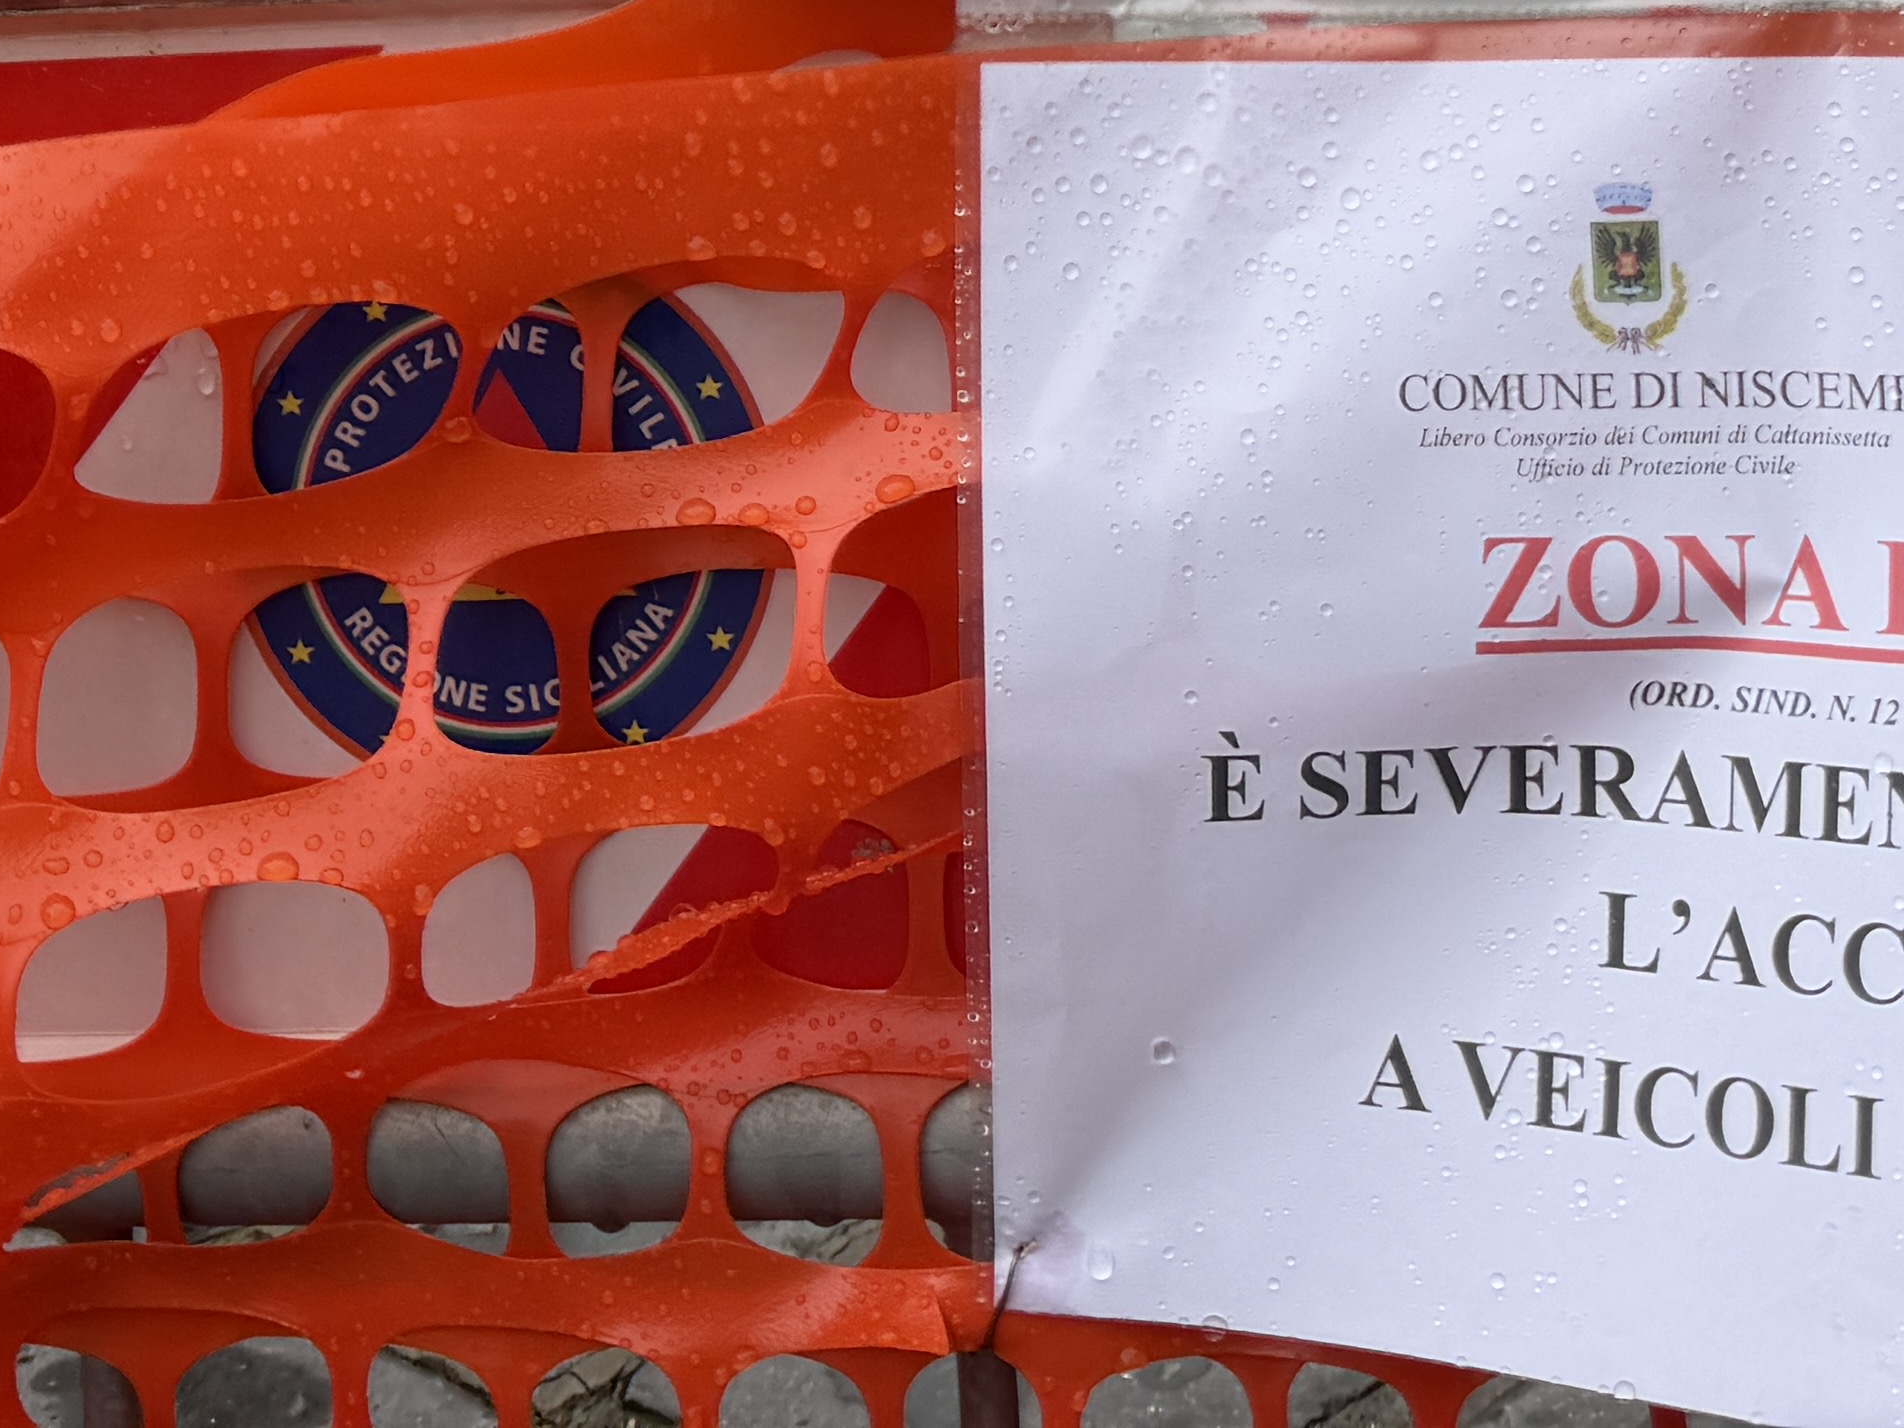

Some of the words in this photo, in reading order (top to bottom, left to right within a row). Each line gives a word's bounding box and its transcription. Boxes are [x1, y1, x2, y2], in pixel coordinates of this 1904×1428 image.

[324, 322, 549, 473] PROTEZINE
[570, 344, 679, 451] CVIL
[1399, 372, 1617, 412] COMUNE
[1631, 372, 1680, 410] DI
[1419, 427, 1486, 448] Libero
[1495, 427, 1597, 448] Consorzio
[1604, 426, 1637, 446] dei
[1642, 425, 1722, 447] Comuni
[1728, 425, 1748, 446] di
[1753, 424, 1891, 449] Caltanissetta
[1516, 457, 1585, 482] Ufficio
[1591, 457, 1612, 477] di
[1618, 456, 1727, 477] Protezione
[1734, 455, 1796, 476] Civile
[1479, 534, 1849, 631] ZONA
[344, 607, 489, 712] REGNE
[504, 603, 674, 714] SICIANA
[1629, 679, 1721, 712] (ORD.
[1730, 687, 1818, 721] SIND.
[1826, 695, 1857, 724] N.
[1867, 698, 1901, 727] 12
[1203, 731, 1265, 824] È
[1359, 1032, 1432, 1114] A
[1452, 1040, 1885, 1180] VEICOLI
